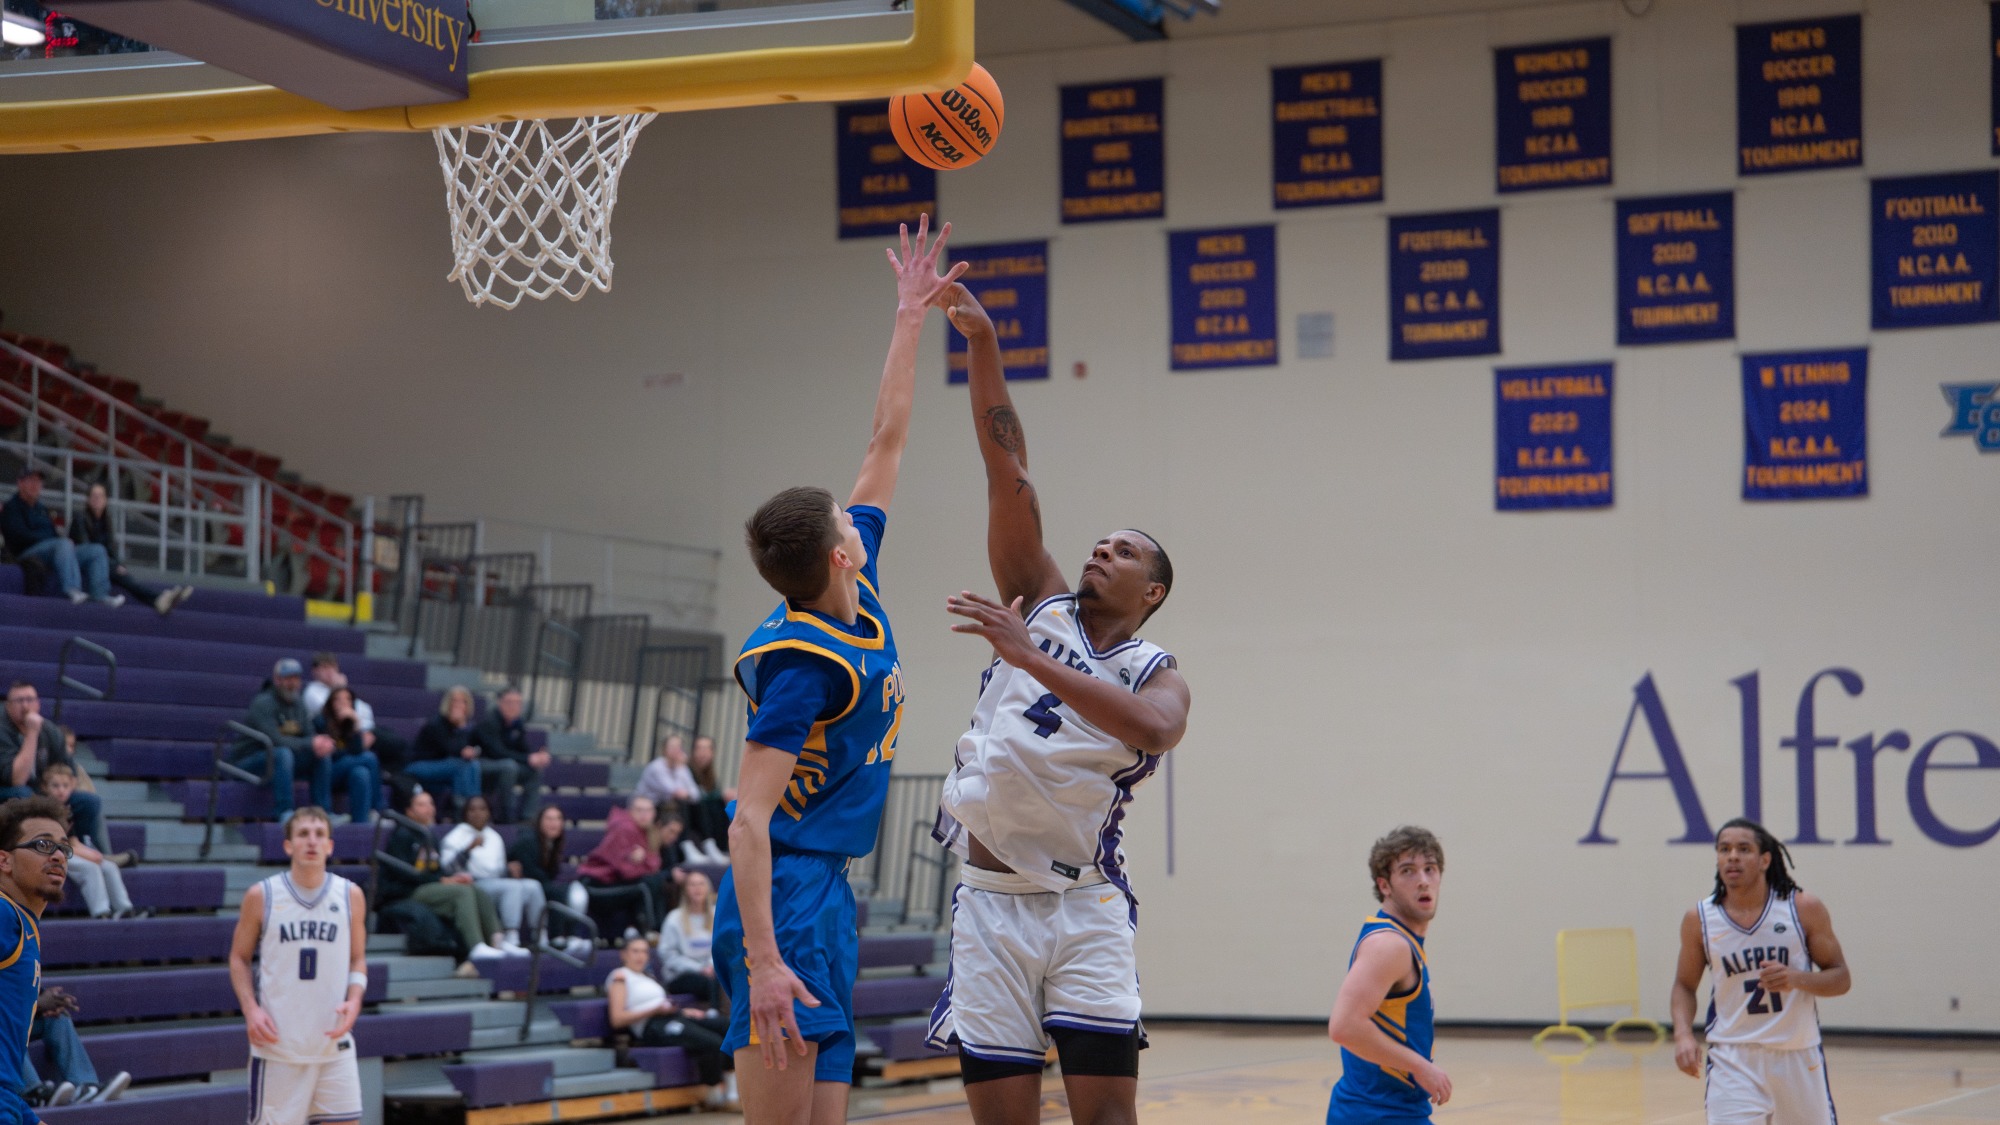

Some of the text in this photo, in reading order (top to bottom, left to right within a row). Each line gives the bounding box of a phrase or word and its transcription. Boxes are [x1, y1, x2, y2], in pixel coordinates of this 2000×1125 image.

[1762, 54, 1836, 81] SOCCER
[1518, 77, 1588, 101] SOCCER
[941, 88, 992, 149] Wilson
[1770, 112, 1826, 136] NCAA
[920, 121, 965, 164] NCAA
[1525, 132, 1579, 155] NCAA
[1742, 138, 1860, 167] TOURNAMENT
[1499, 158, 1609, 184] TOURNAMENT
[1276, 176, 1380, 201] TOURNAMENT
[1885, 193, 1984, 219] FOOTBALL
[1628, 209, 1720, 235] SOFTBALL
[1912, 223, 1958, 246] 2010
[1398, 228, 1488, 252] FOOTBALL
[1889, 281, 1982, 307] TOURNAMENT
[1631, 302, 1719, 328] TOURNAMENT
[1402, 319, 1488, 343] TOURNAMENT
[1173, 338, 1274, 363] TOURNAMENT
[1501, 375, 1606, 400] VOLLEYBALL
[1781, 362, 1850, 387] TENNIS
[1779, 400, 1830, 423] 2024
[1498, 472, 1609, 497] TOURNAMENT
[1747, 460, 1863, 487] TOURNAMENT
[1023, 693, 1063, 739] 4
[280, 920, 338, 943] ALFRED
[299, 948, 317, 980] 0
[1722, 946, 1789, 978] ALFRED
[1744, 979, 1783, 1015] 21
